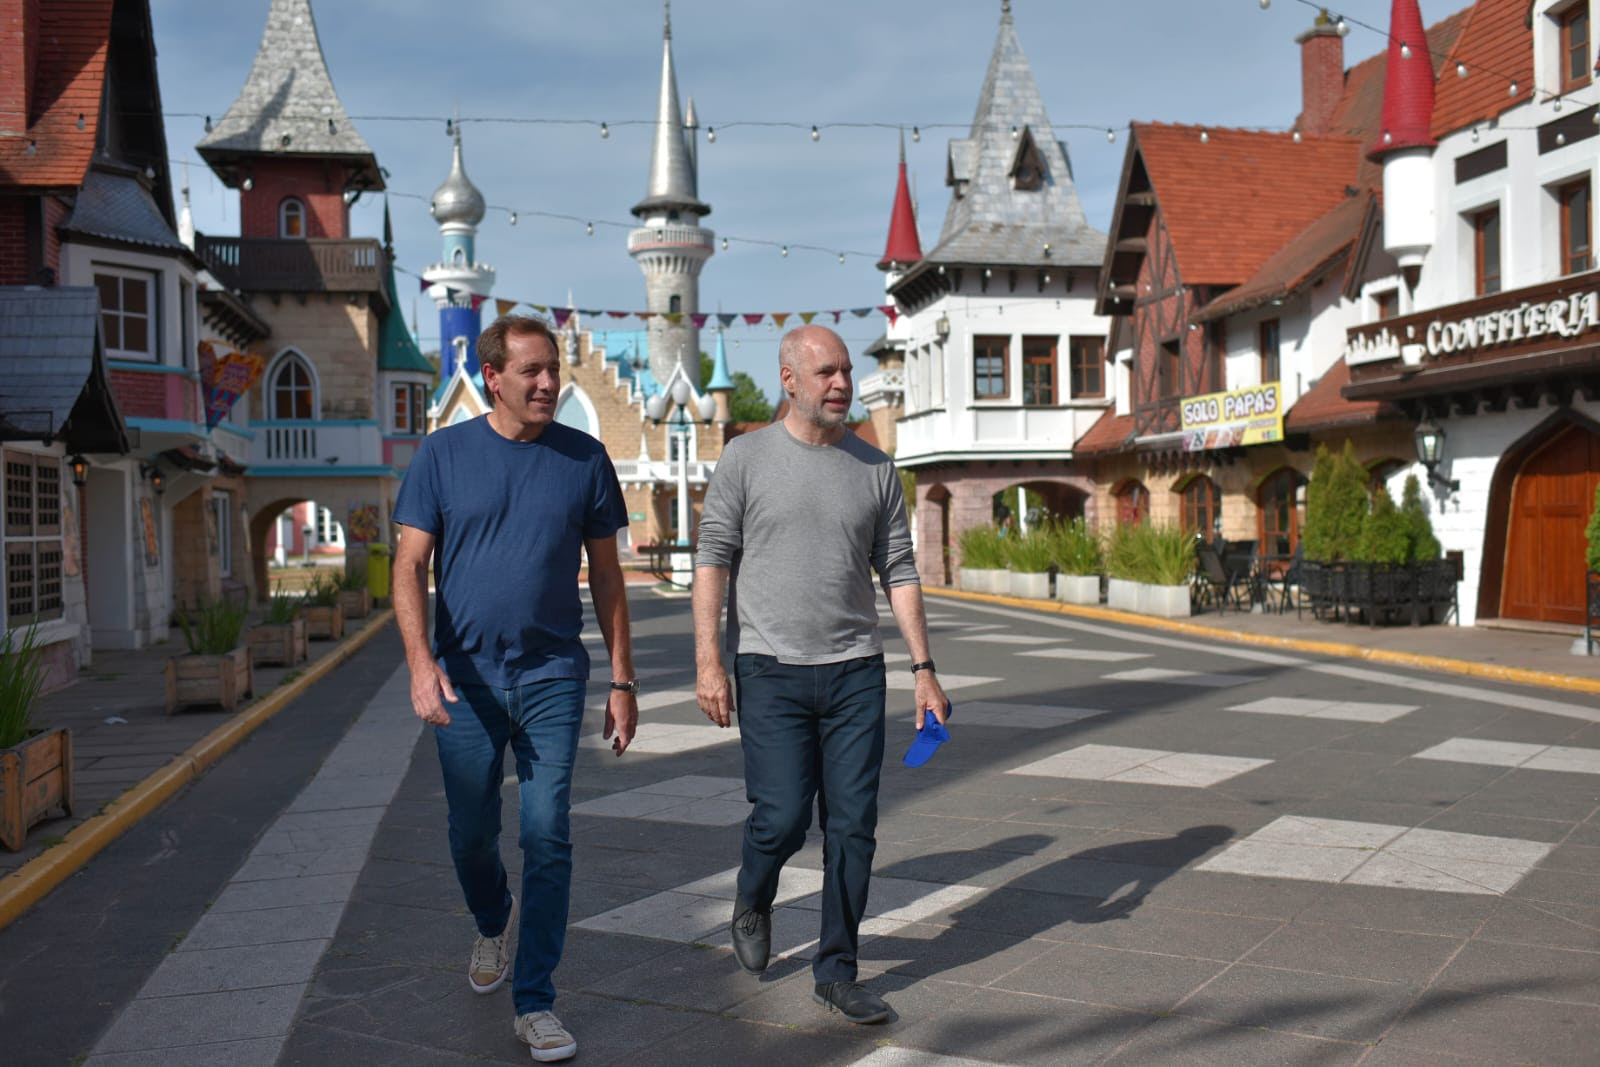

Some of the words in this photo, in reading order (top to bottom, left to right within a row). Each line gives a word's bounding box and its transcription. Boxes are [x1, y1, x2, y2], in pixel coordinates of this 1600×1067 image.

[1426, 291, 1600, 356] CONFITERIA
[1184, 399, 1219, 425] SOLO
[1224, 387, 1276, 420] PAPAS
